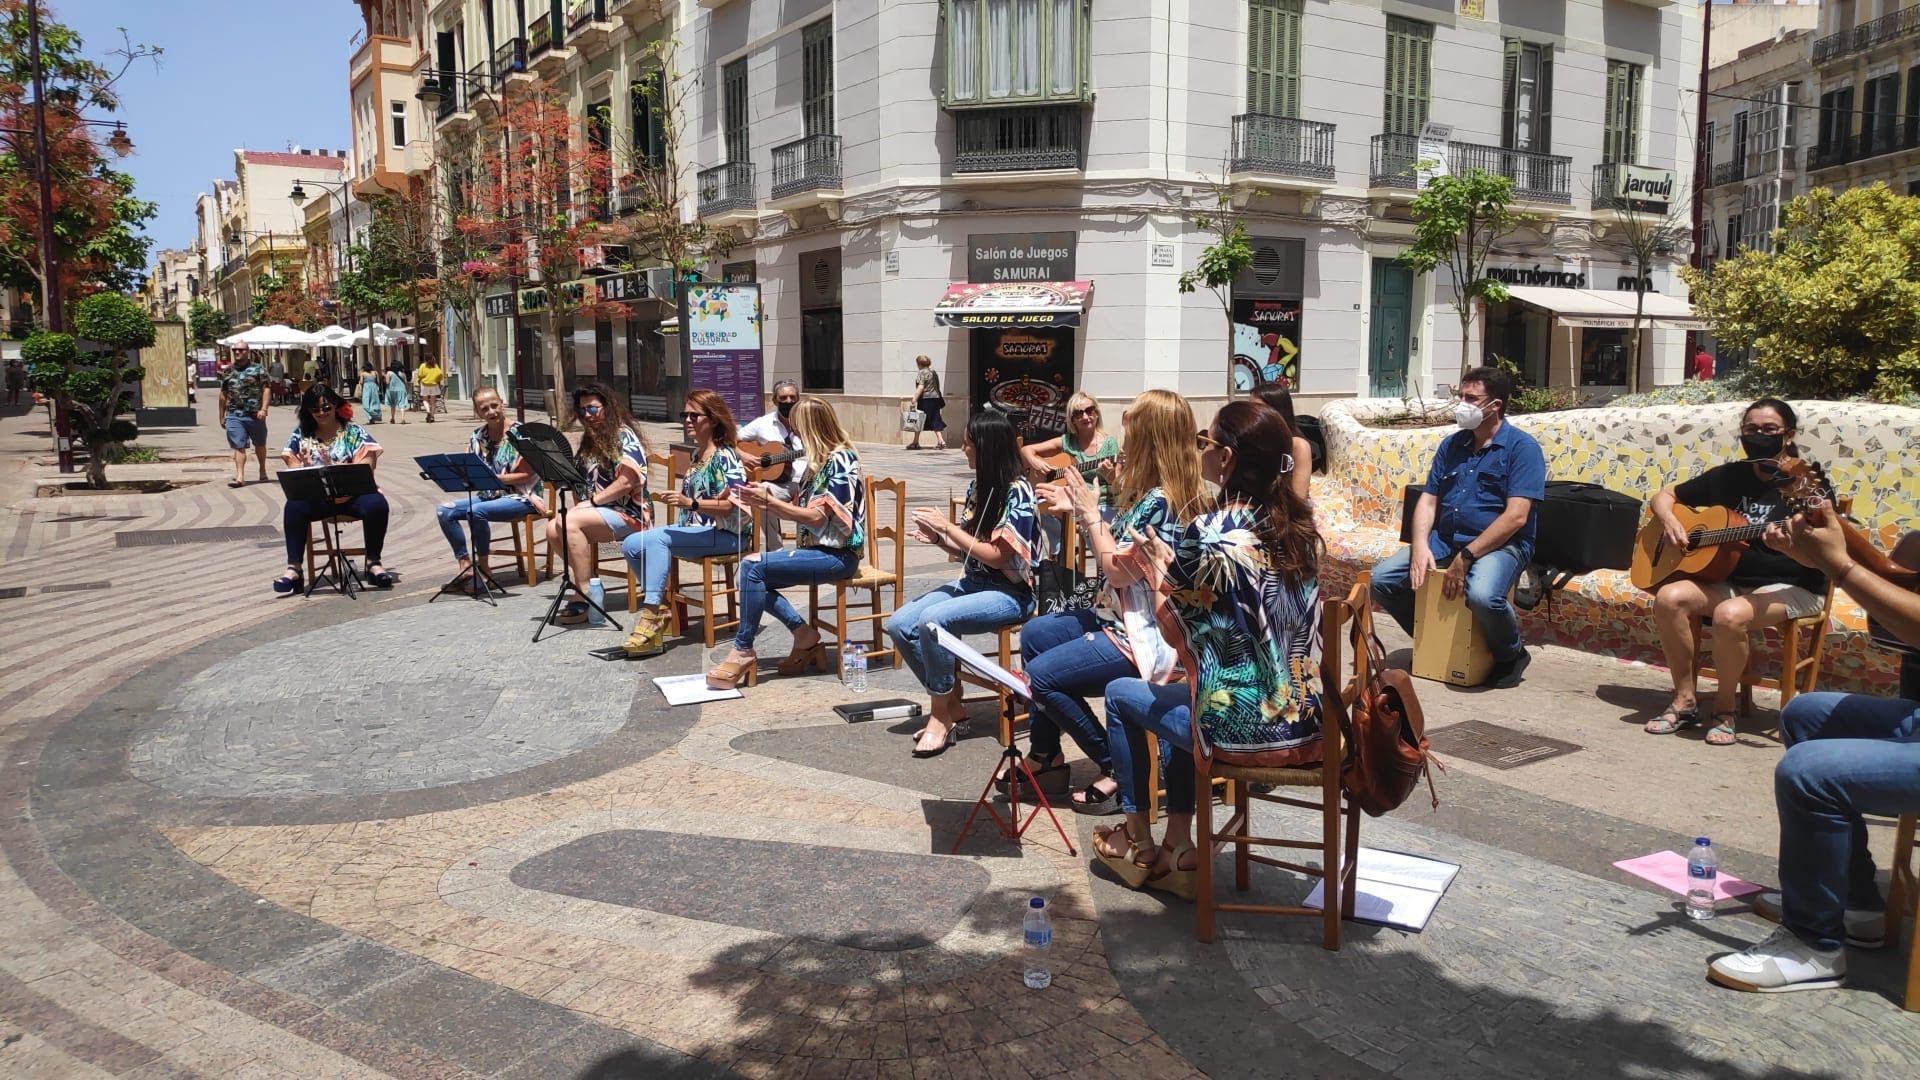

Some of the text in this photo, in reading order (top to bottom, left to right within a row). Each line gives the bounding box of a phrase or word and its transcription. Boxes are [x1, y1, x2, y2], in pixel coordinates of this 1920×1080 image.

[975, 246, 1069, 261] Salón de Juegos
[993, 266, 1050, 280] SAMURAI
[962, 315, 1054, 323] SALON DE JUEGO
[1003, 344, 1048, 353] SAMURAI
